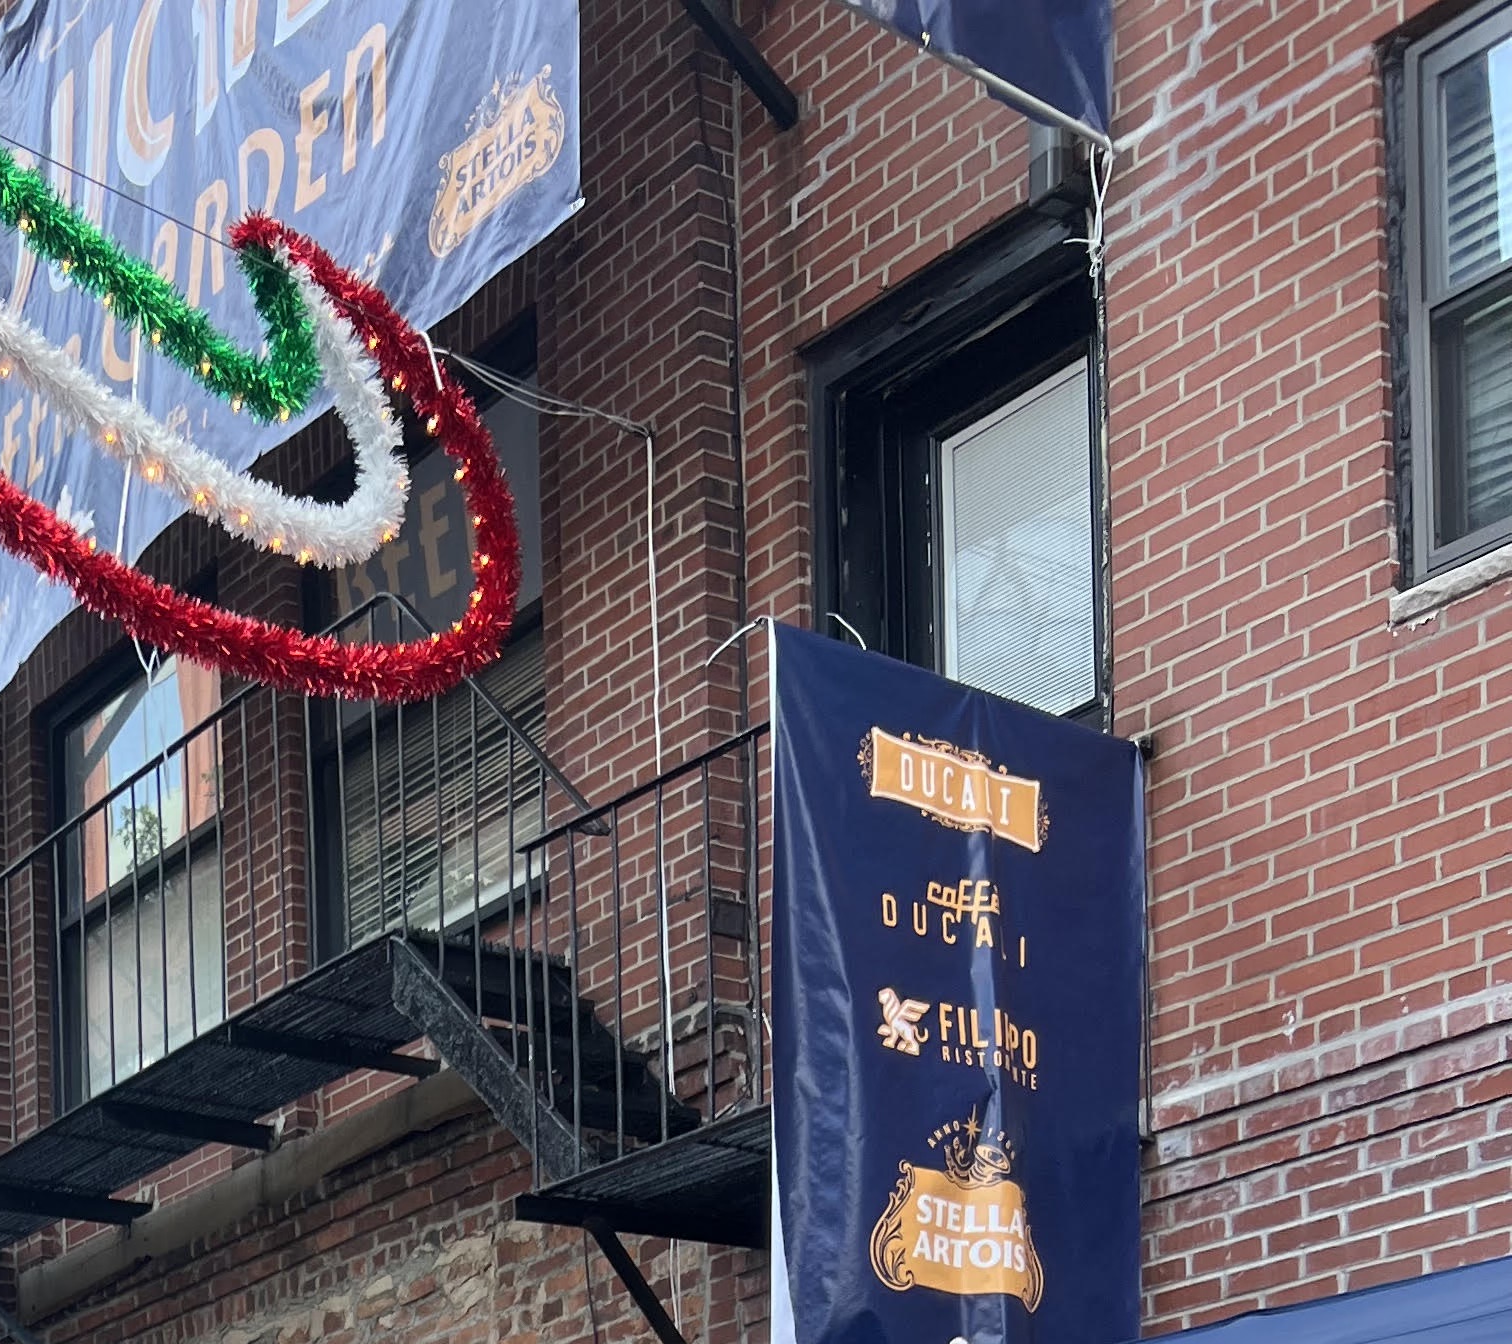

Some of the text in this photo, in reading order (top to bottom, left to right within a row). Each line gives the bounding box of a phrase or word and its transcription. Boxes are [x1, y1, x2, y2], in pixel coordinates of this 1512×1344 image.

[455, 106, 536, 193] STELLA
[455, 131, 537, 223] ARTOIS
[336, 480, 476, 645] BEE
[911, 1230, 1027, 1273] ARTOIS
[915, 1193, 1026, 1239] STELLA
